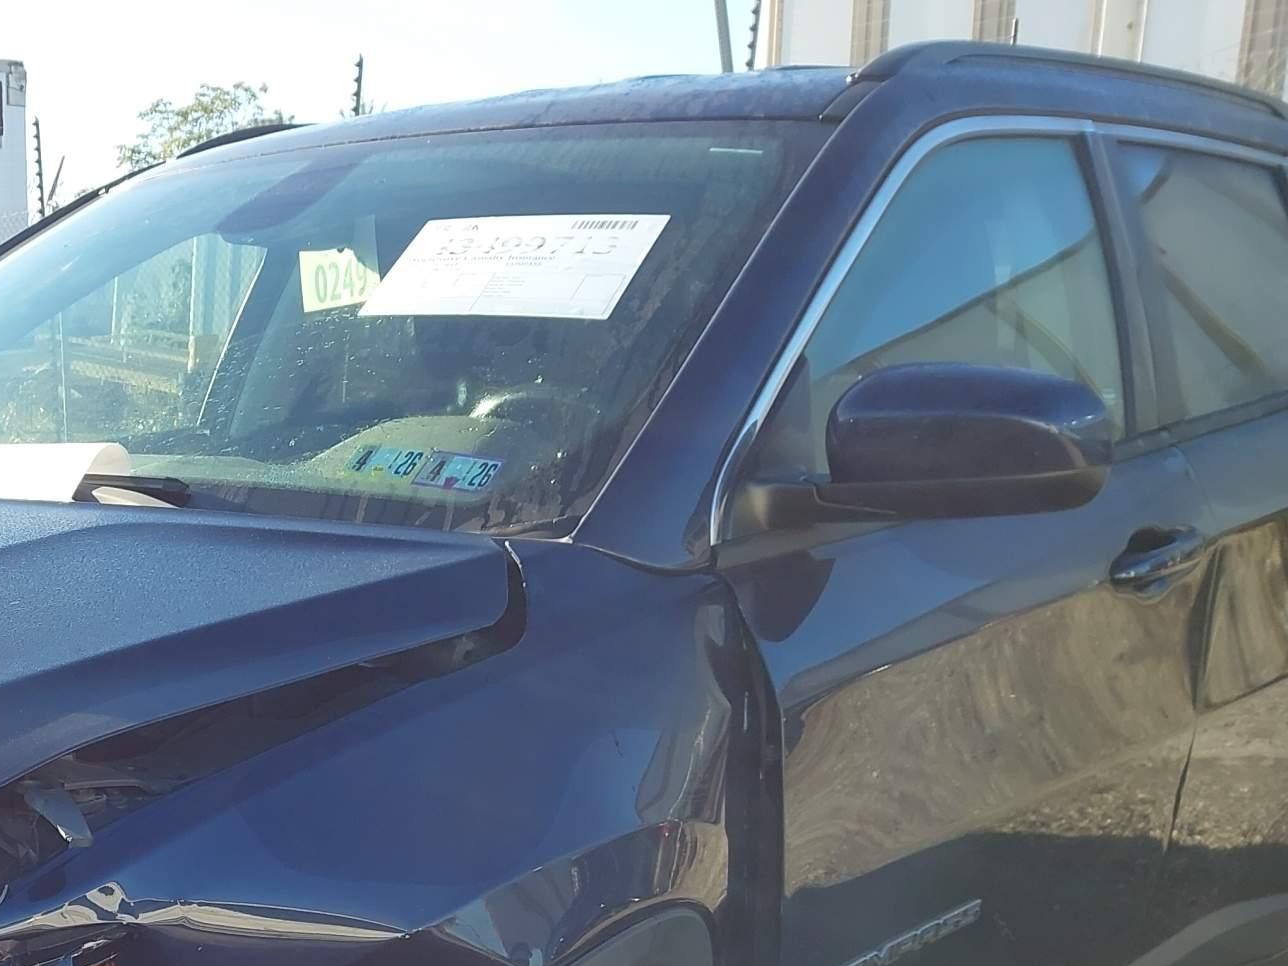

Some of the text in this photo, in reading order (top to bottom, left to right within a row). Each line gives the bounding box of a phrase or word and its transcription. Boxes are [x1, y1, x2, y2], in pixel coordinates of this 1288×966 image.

[314, 258, 368, 304] 0249
[393, 450, 424, 477] 26
[467, 461, 498, 488] 26
